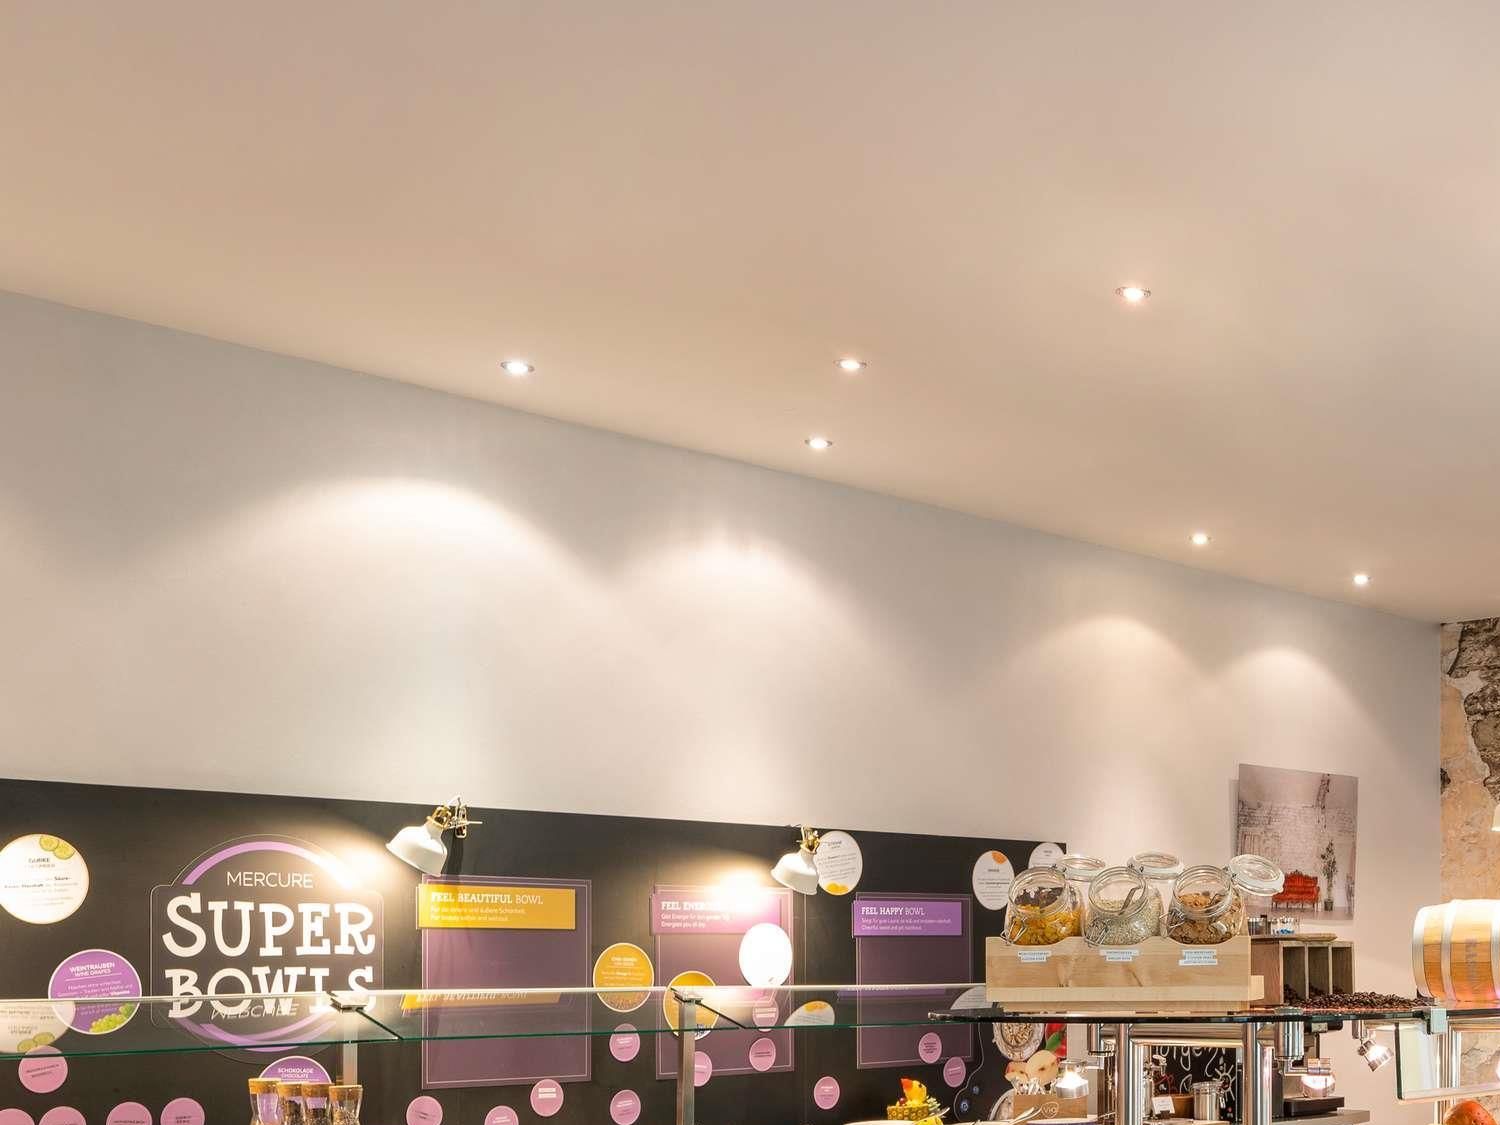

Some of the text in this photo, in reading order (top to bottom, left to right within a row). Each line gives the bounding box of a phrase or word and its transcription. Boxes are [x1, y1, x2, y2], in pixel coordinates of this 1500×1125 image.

[226, 871, 314, 888] MERCURE
[431, 892, 544, 905] FEEL BEAUTIFUL BOWL
[661, 901, 681, 911] FEEL
[861, 906, 926, 916] FEEL HAPPY BOWL
[162, 892, 376, 958] SUPER
[69, 962, 115, 973] WEINTRAUBEN
